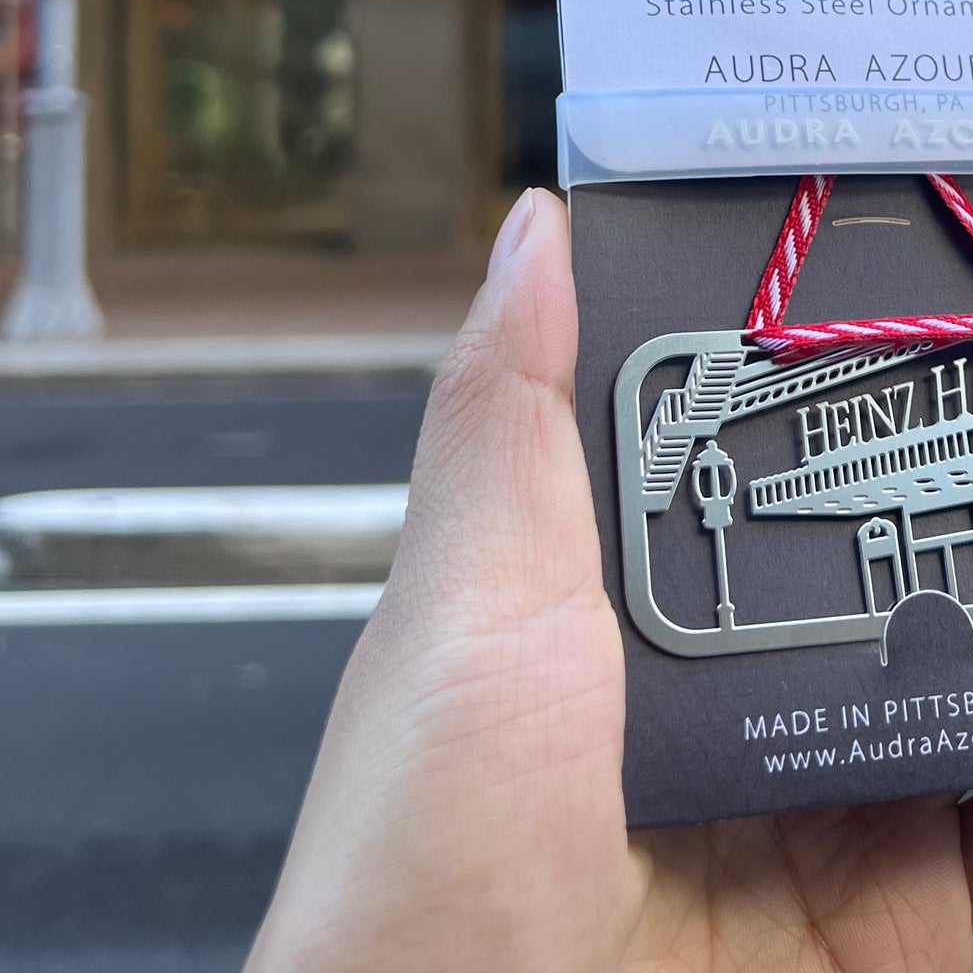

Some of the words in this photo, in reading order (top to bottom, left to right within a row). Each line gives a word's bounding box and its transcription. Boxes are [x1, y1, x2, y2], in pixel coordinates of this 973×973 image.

[704, 54, 836, 84] AUDRA
[764, 93, 928, 115] PITTSBURGH,
[936, 94, 964, 112] PA
[705, 117, 860, 148] AUDRA
[797, 381, 921, 459] HEINZ
[743, 709, 829, 742] MADE
[841, 703, 870, 729] IN
